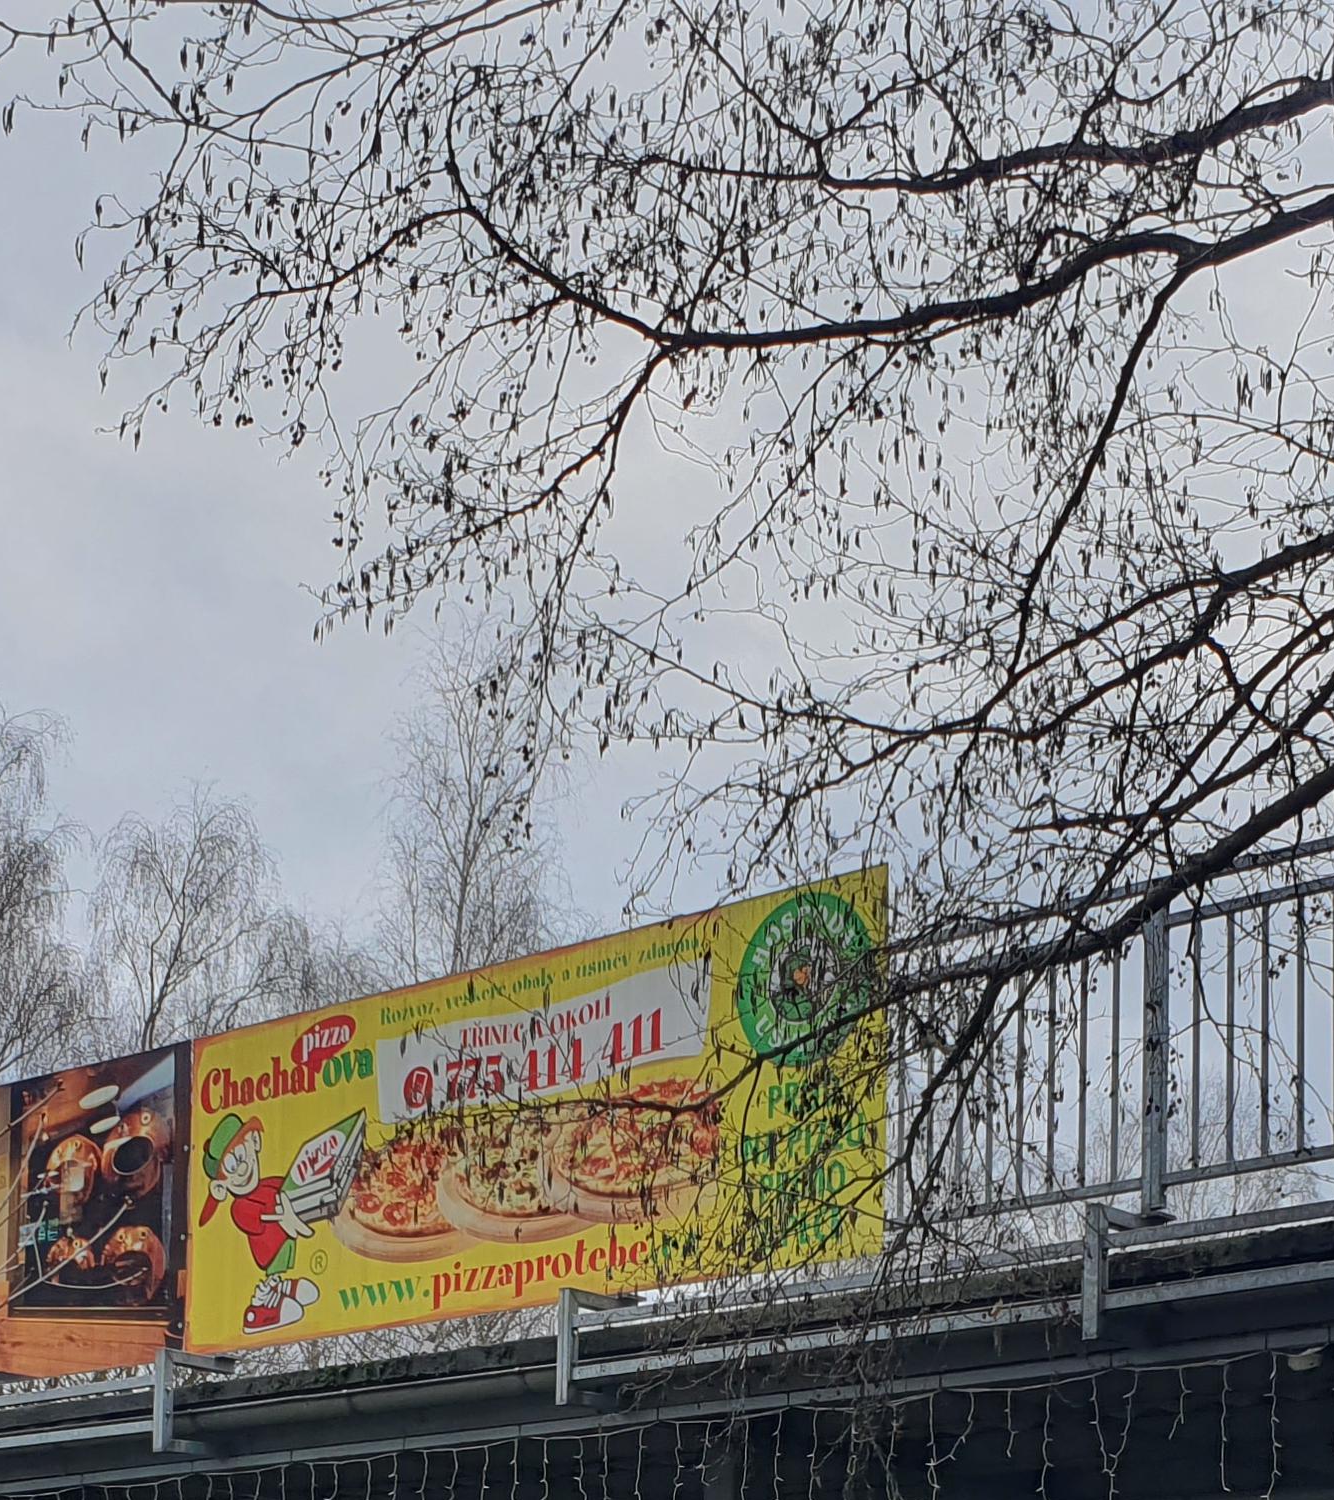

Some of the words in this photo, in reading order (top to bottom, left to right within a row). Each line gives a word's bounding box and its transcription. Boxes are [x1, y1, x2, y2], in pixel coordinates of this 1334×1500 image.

[301, 1023, 351, 1063] pizza
[445, 1055, 505, 1102] 775
[520, 1038, 586, 1092] 414
[602, 1007, 665, 1066] 411
